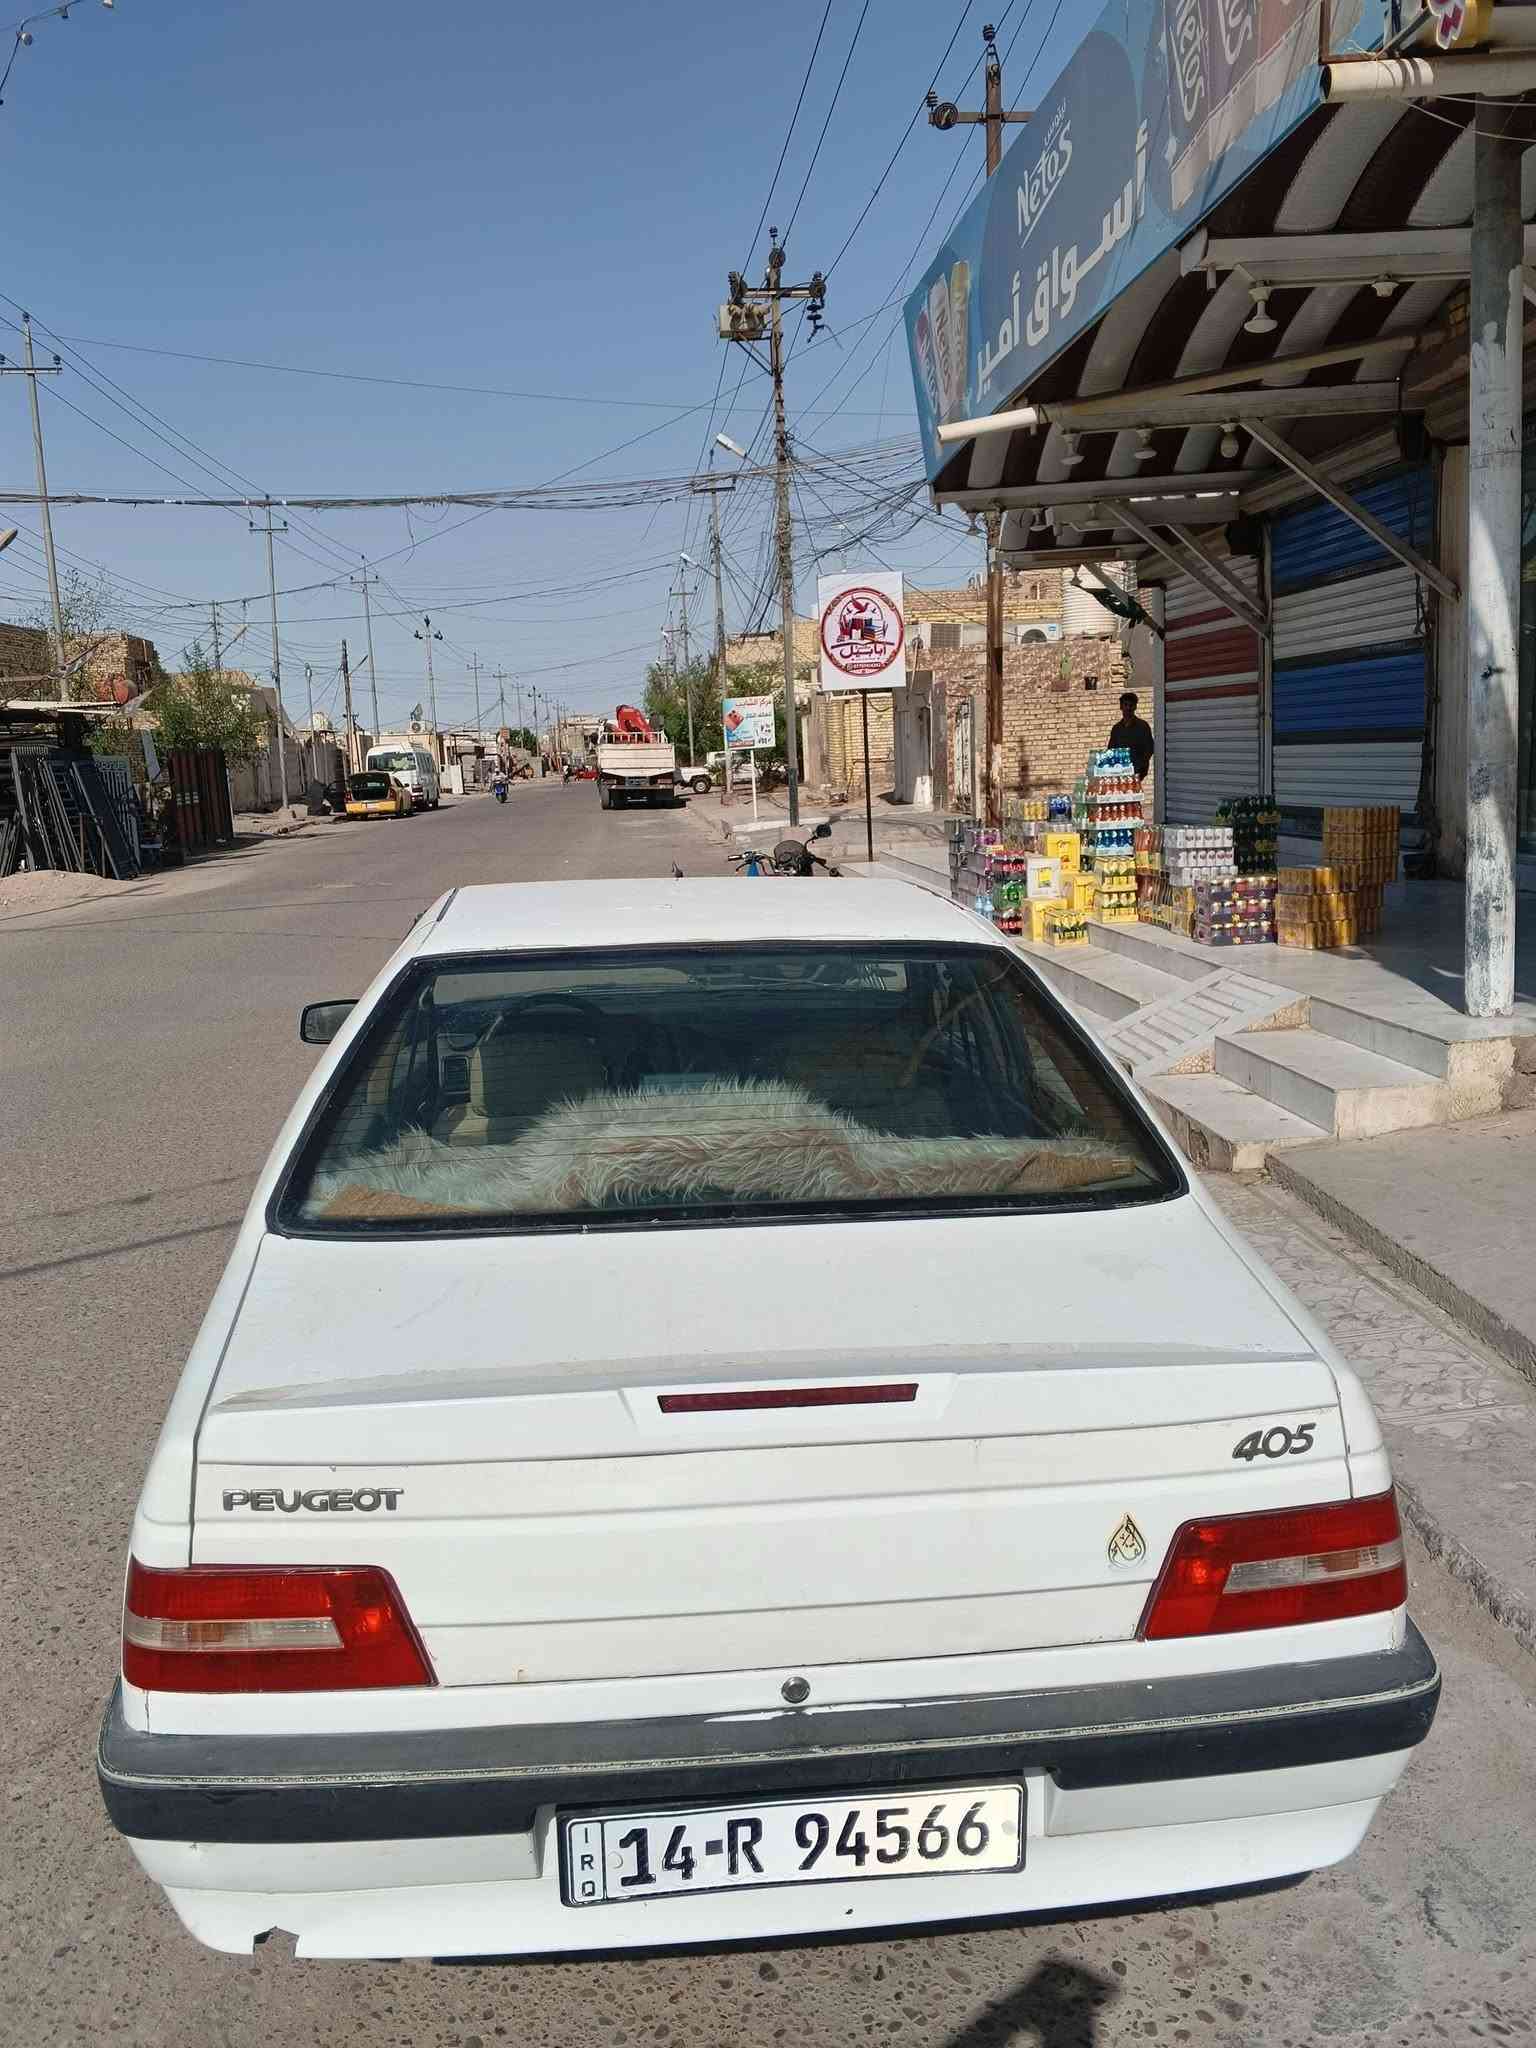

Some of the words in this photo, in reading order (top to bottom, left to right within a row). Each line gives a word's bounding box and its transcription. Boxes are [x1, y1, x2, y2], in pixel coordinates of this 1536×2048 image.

[1017, 120, 1073, 237] Netos
[977, 270, 1021, 403] أمير
[1231, 1422, 1317, 1462] 405
[222, 1488, 404, 1513] PEUGEOT
[619, 1816, 765, 1887] 14-R
[794, 1800, 991, 1871] 94566
